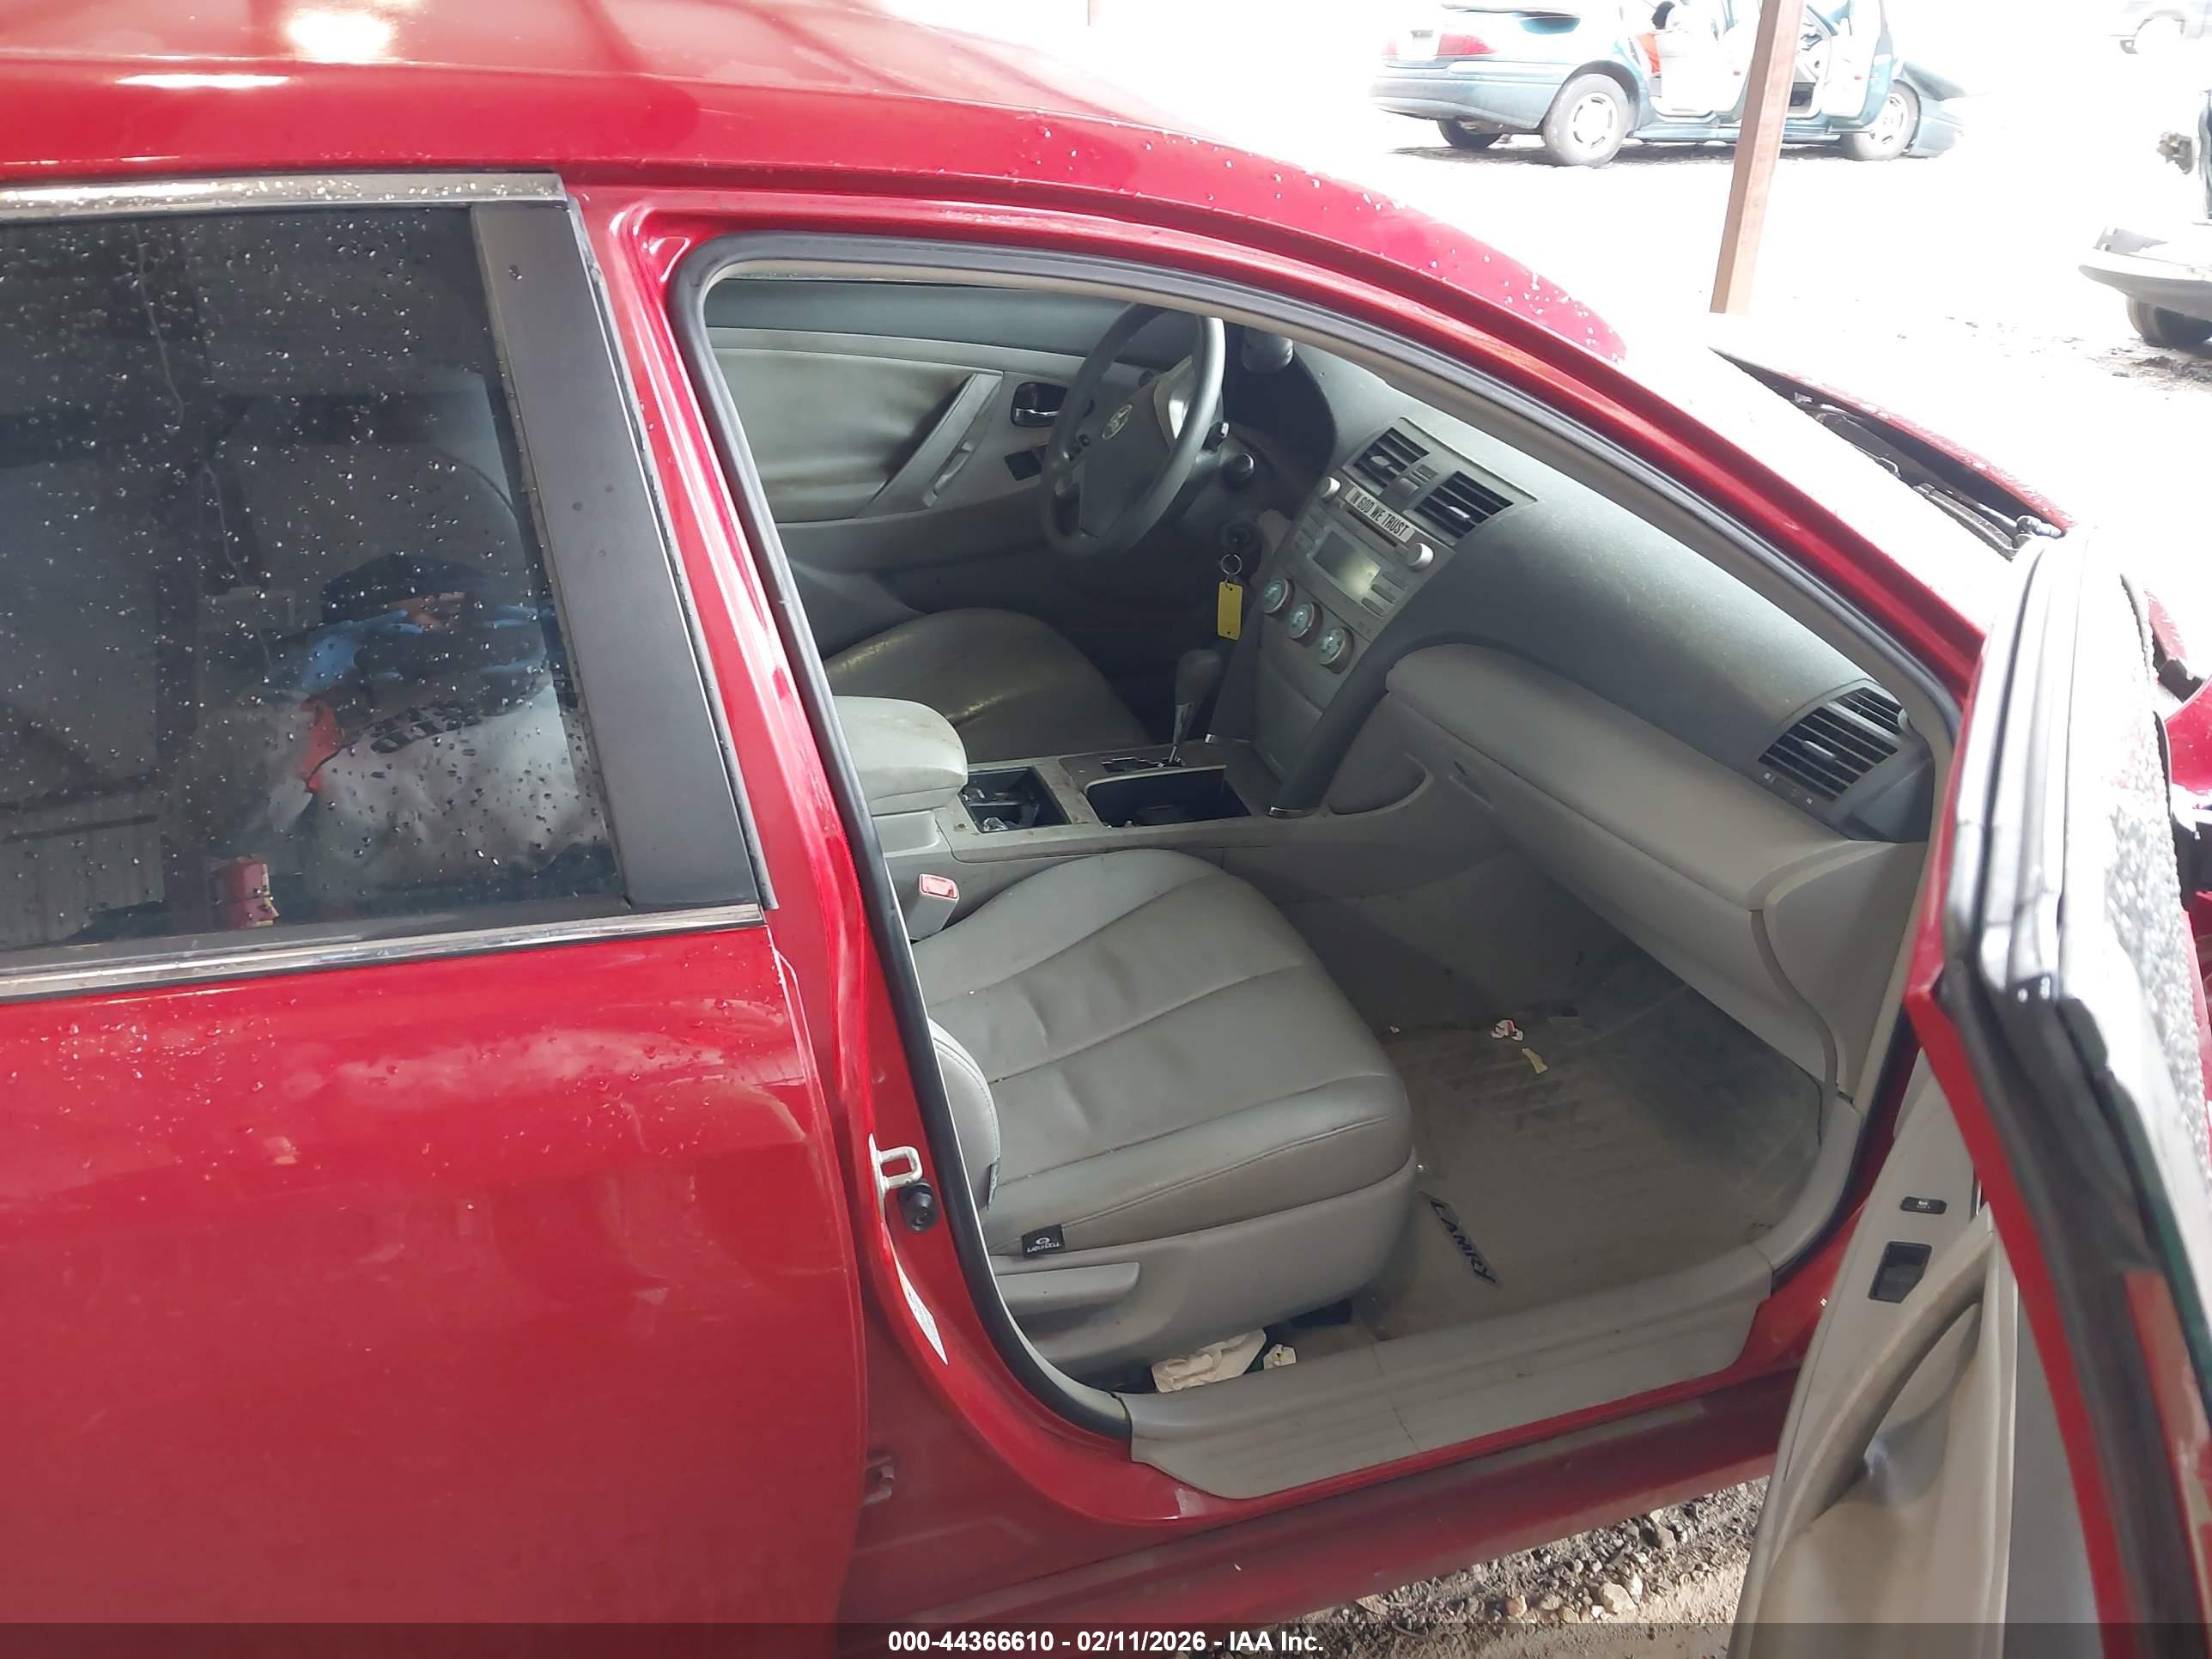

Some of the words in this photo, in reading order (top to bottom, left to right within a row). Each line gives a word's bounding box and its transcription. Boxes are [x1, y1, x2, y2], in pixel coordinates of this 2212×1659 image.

[1349, 490, 1363, 505] IN
[1357, 496, 1375, 514] GOD
[1370, 505, 1386, 522] WE
[1381, 513, 1410, 537] TRUST
